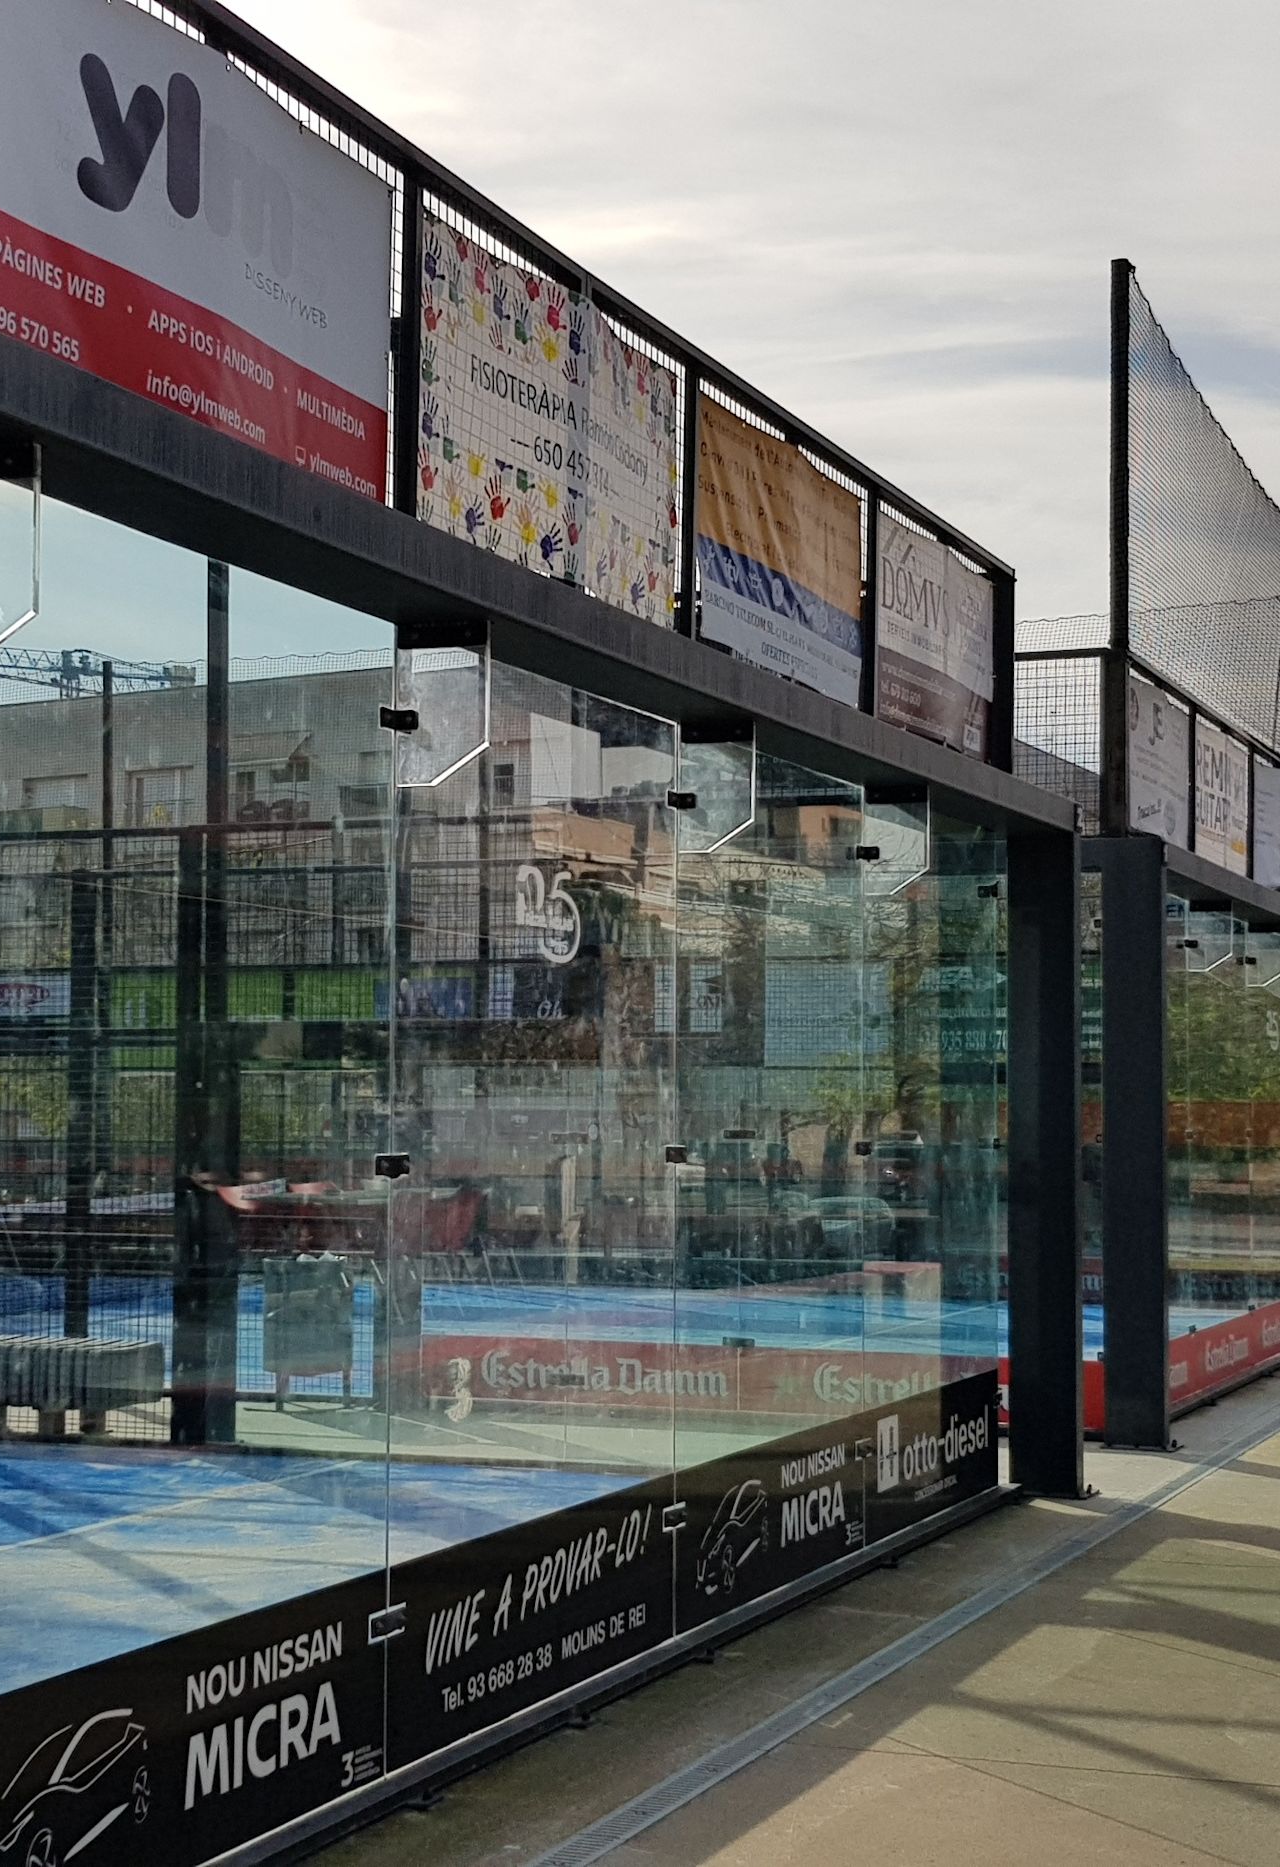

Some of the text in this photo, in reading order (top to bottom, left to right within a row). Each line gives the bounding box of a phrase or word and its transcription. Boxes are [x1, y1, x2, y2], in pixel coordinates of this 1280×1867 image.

[67, 272, 106, 308] WEB
[245, 263, 329, 329] DISSENY WEB
[20, 316, 49, 348] 570
[52, 331, 80, 362] 565
[148, 310, 187, 343] APPS
[223, 345, 274, 390] ANDROID
[147, 370, 266, 445] info@ylmweb.com
[297, 389, 366, 440] MULTIMÈDIA
[471, 354, 578, 430] FISIOTERÀPIA
[309, 453, 377, 499] ylmweb.com
[534, 436, 562, 470] 650
[567, 450, 592, 482] 457
[616, 1357, 729, 1398] Damm
[813, 1361, 934, 1405] Estrell
[781, 1443, 845, 1489] NOU NISSAN
[903, 1404, 989, 1481] otto-diesel
[781, 1480, 846, 1548] MICRA
[426, 1503, 652, 1675] VINE A PROVAR-LO!
[186, 1621, 343, 1714] NOU NISSAN
[441, 1603, 646, 1712] Tel. 93 668 28 38 MOLINS DE REI
[184, 1681, 341, 1811] MICRA
[340, 1750, 354, 1788] 3
